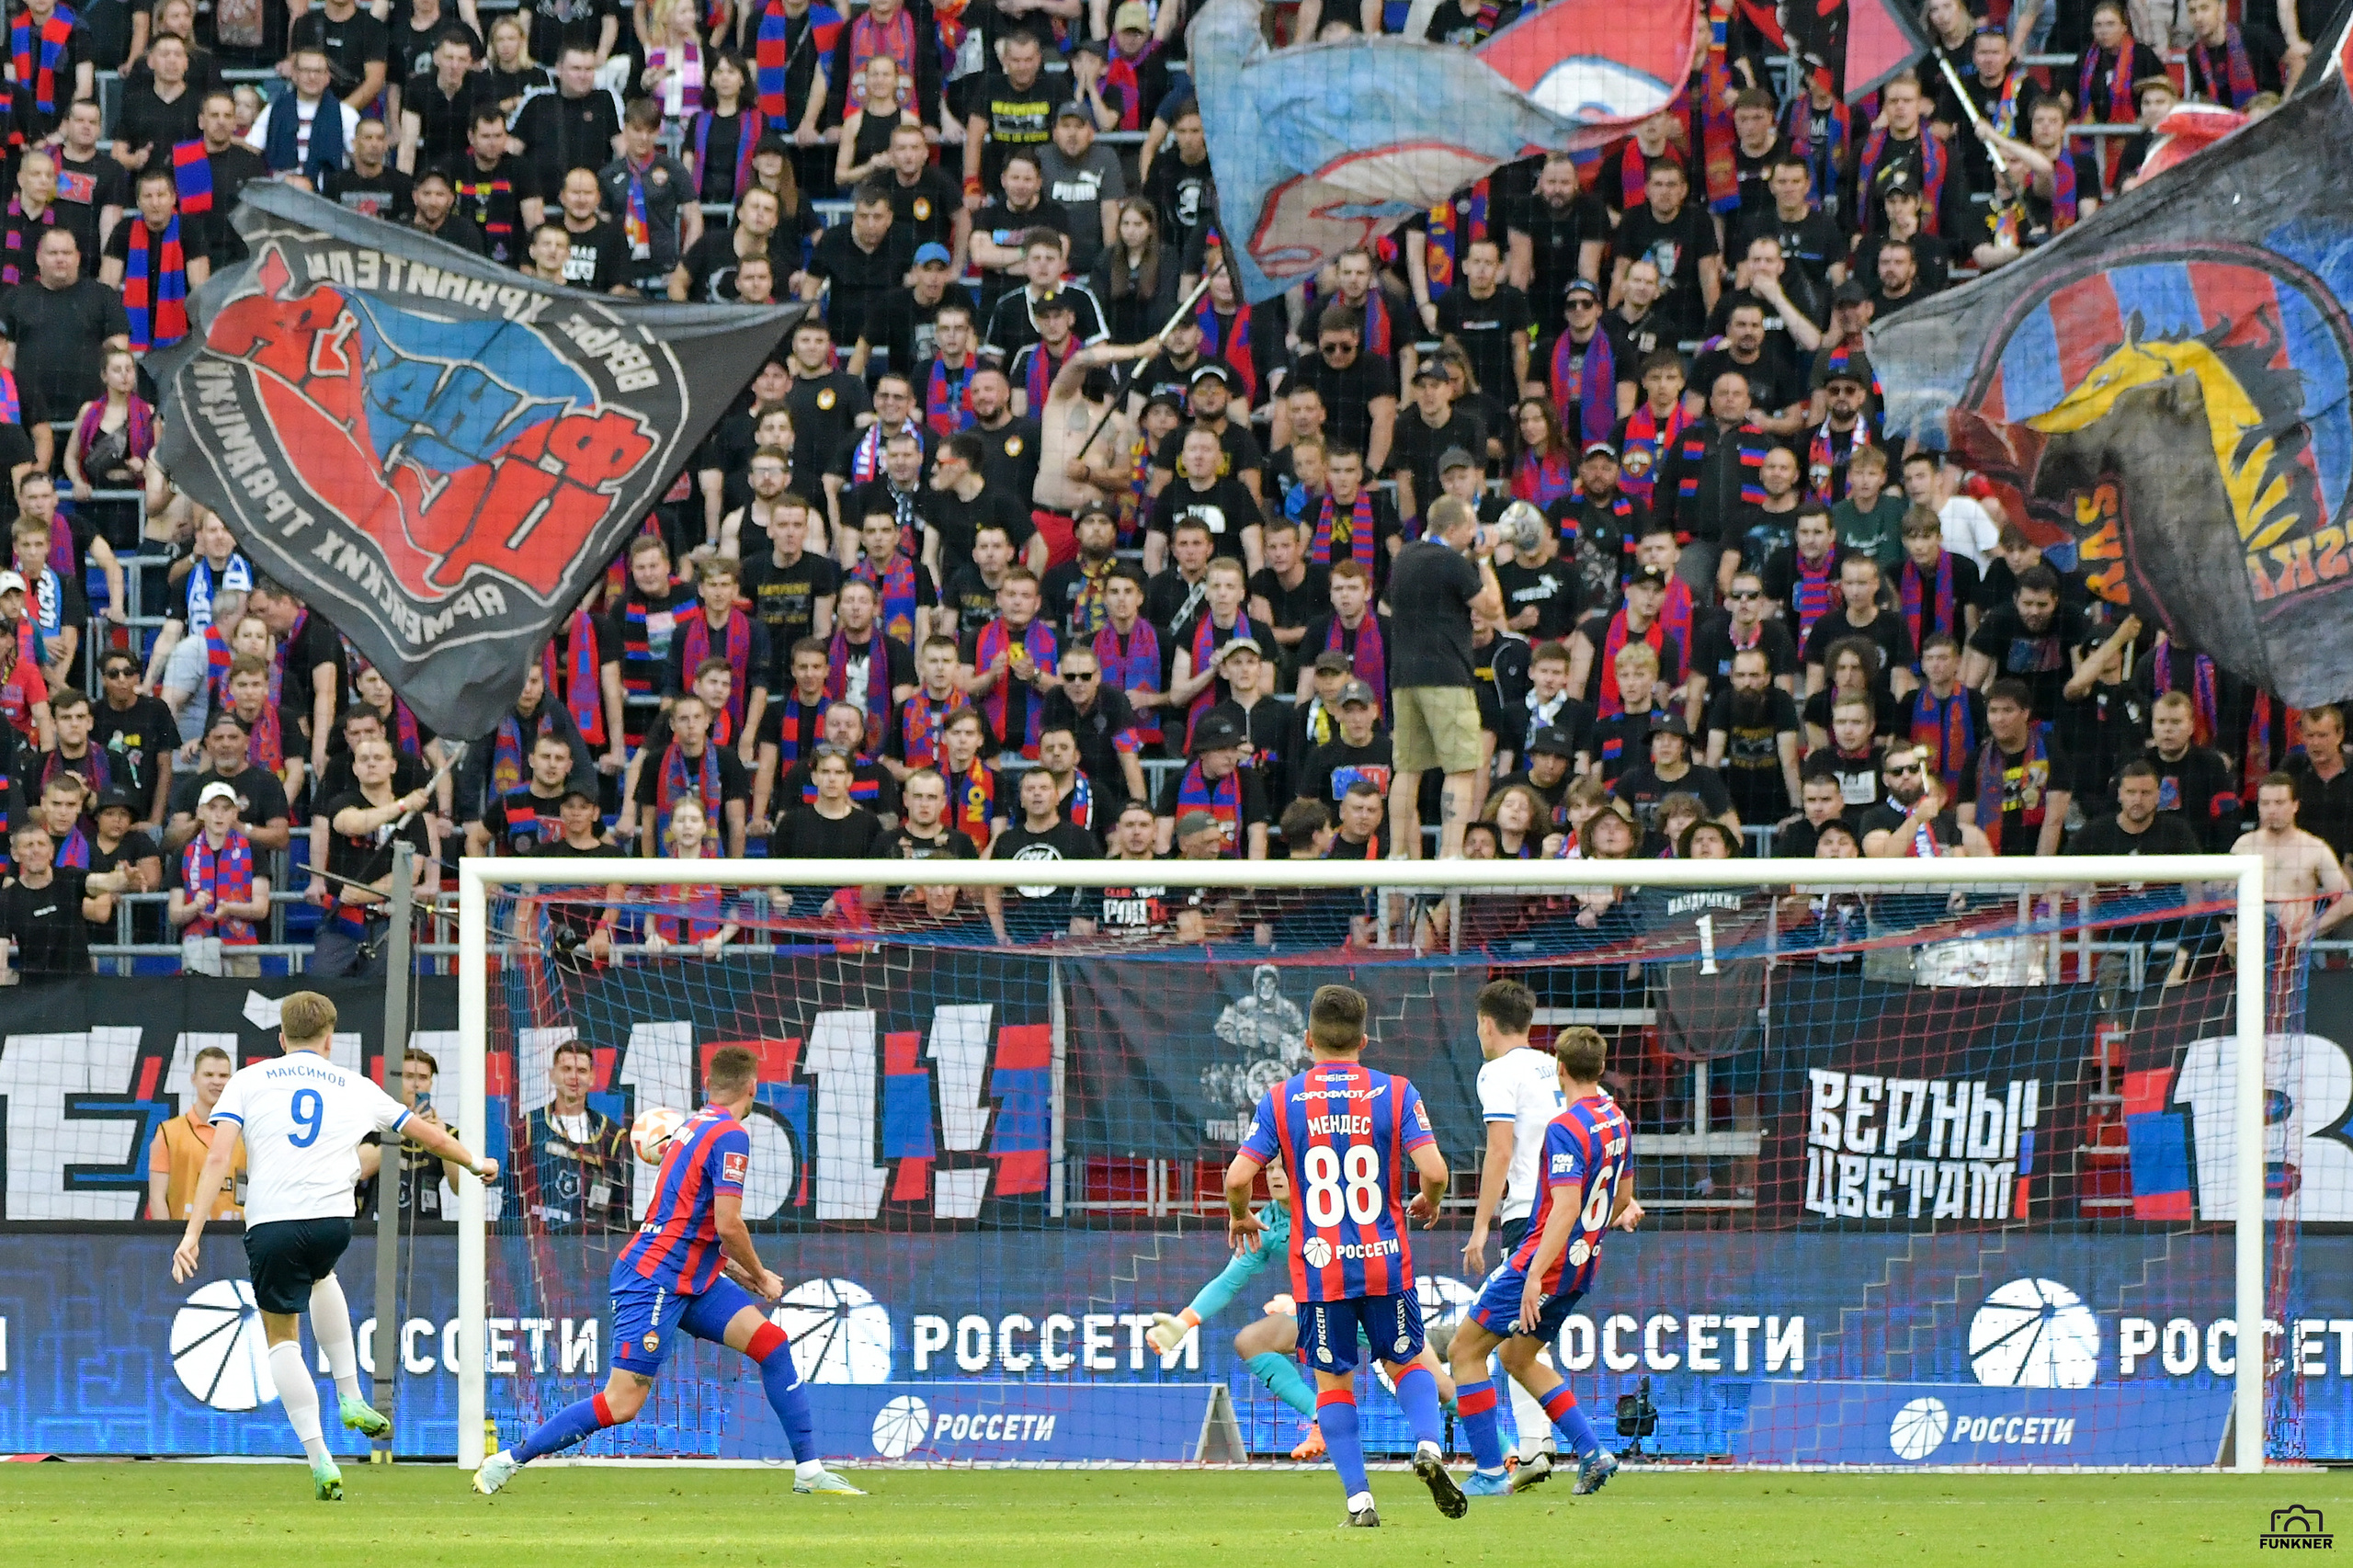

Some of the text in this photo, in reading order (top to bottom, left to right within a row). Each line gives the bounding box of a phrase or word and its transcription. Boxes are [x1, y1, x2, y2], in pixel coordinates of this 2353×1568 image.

[1695, 913, 1719, 975] 1
[267, 1070, 347, 1088] МАКСИМОВ
[1290, 1089, 1366, 1103] АЭРОФЛОТ
[288, 1088, 324, 1148] 9
[1306, 1114, 1372, 1138] МЕНДЕС
[1552, 1153, 1574, 1165] FON
[1552, 1163, 1574, 1175] BET
[1303, 1143, 1383, 1229] 88
[1804, 1146, 2018, 1221] ЦВЕТАМ
[1335, 1237, 1400, 1260] РОССЕТИ
[1314, 1306, 1327, 1346] РОССЕТИ
[912, 1313, 1200, 1372] РОССЕТИ
[1557, 1313, 1806, 1372] ОССЕТИ
[933, 1414, 1057, 1442] РОССЕТИ
[1950, 1415, 2076, 1446] РОССЕТИ
